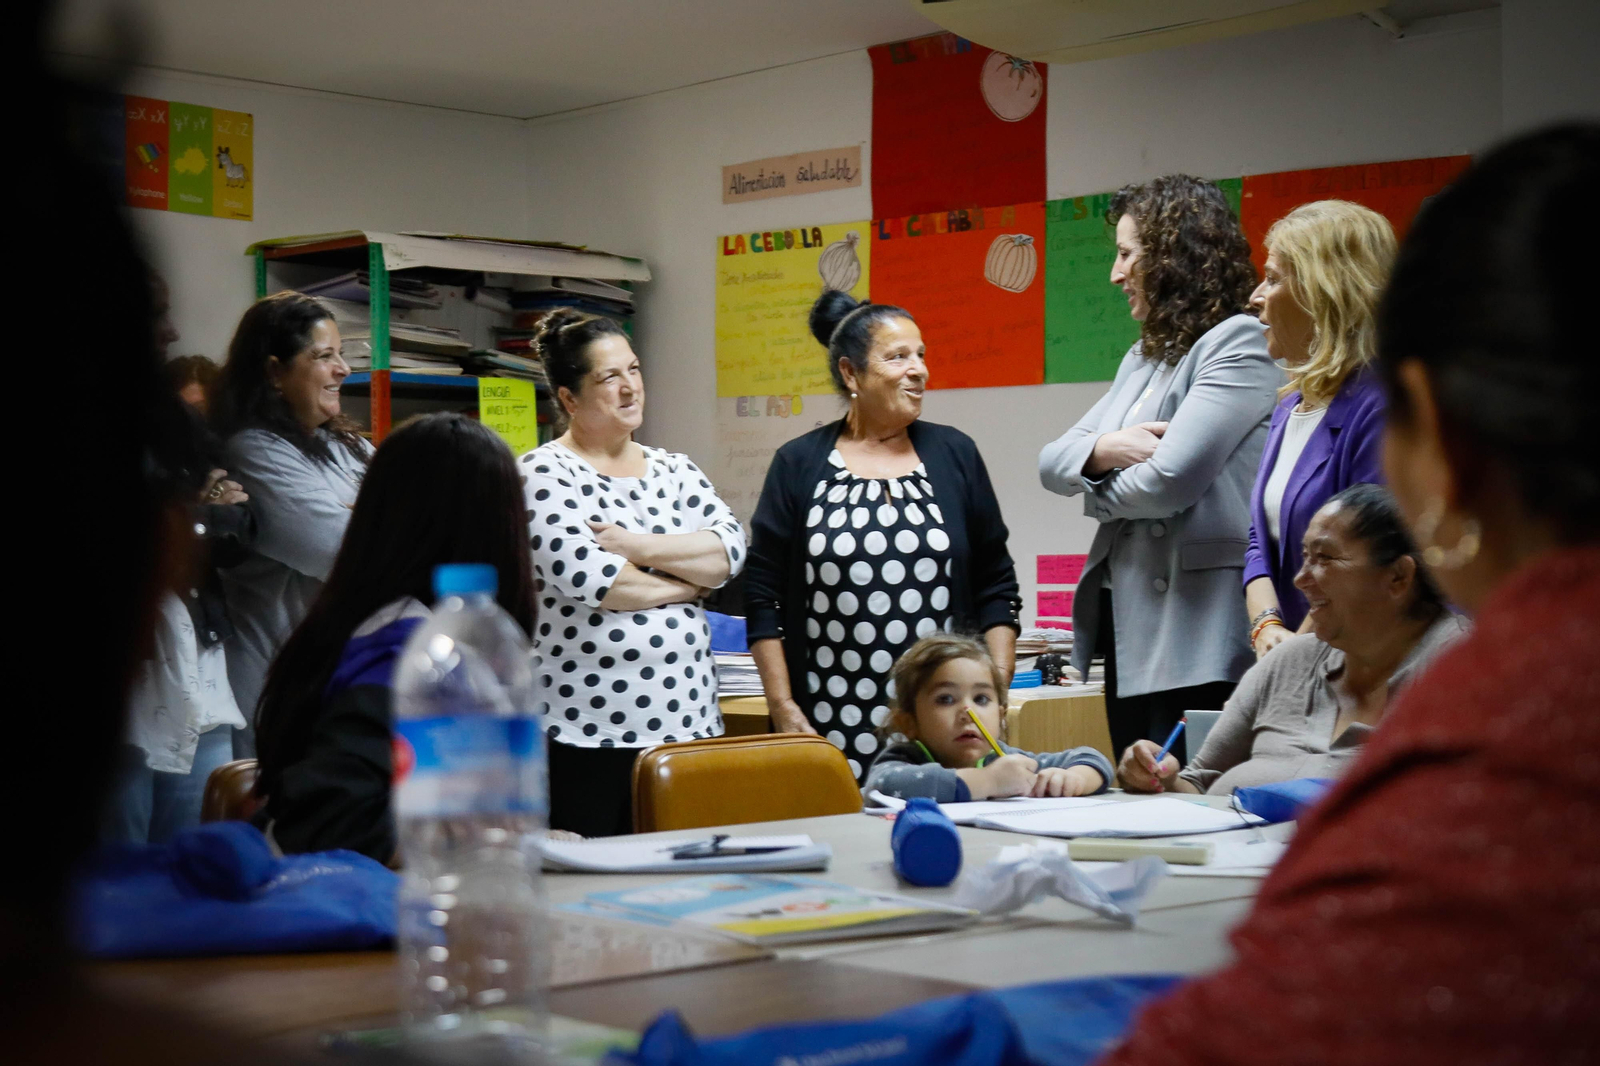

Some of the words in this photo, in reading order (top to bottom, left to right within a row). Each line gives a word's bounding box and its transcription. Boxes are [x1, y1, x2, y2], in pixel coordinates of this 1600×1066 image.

[907, 205, 1015, 236] CALABAA
[723, 234, 747, 256] LA
[750, 227, 823, 253] CEBOLLA
[735, 395, 760, 417] EL
[766, 394, 803, 418] AJO
